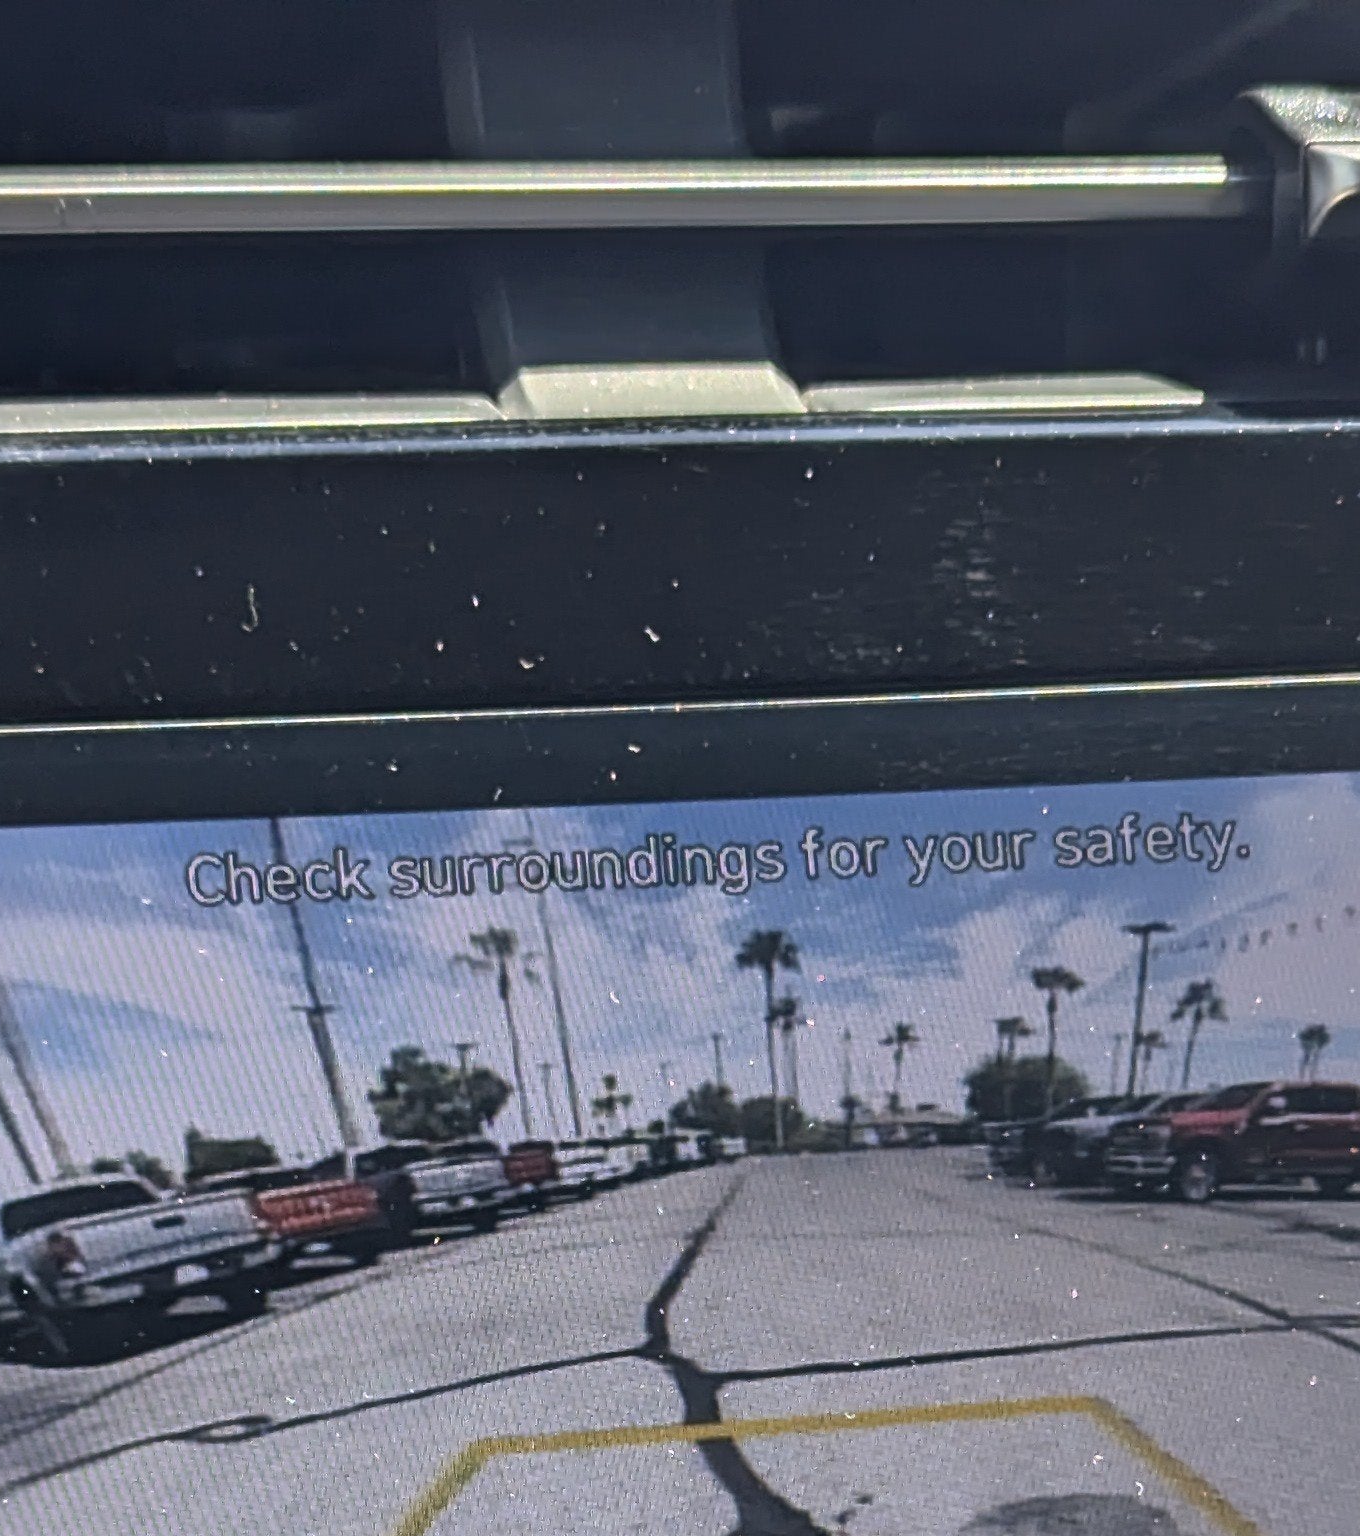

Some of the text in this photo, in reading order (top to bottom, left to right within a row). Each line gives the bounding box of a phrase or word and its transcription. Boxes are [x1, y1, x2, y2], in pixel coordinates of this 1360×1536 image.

[186, 811, 1252, 906] Check surroundings for your safety.
